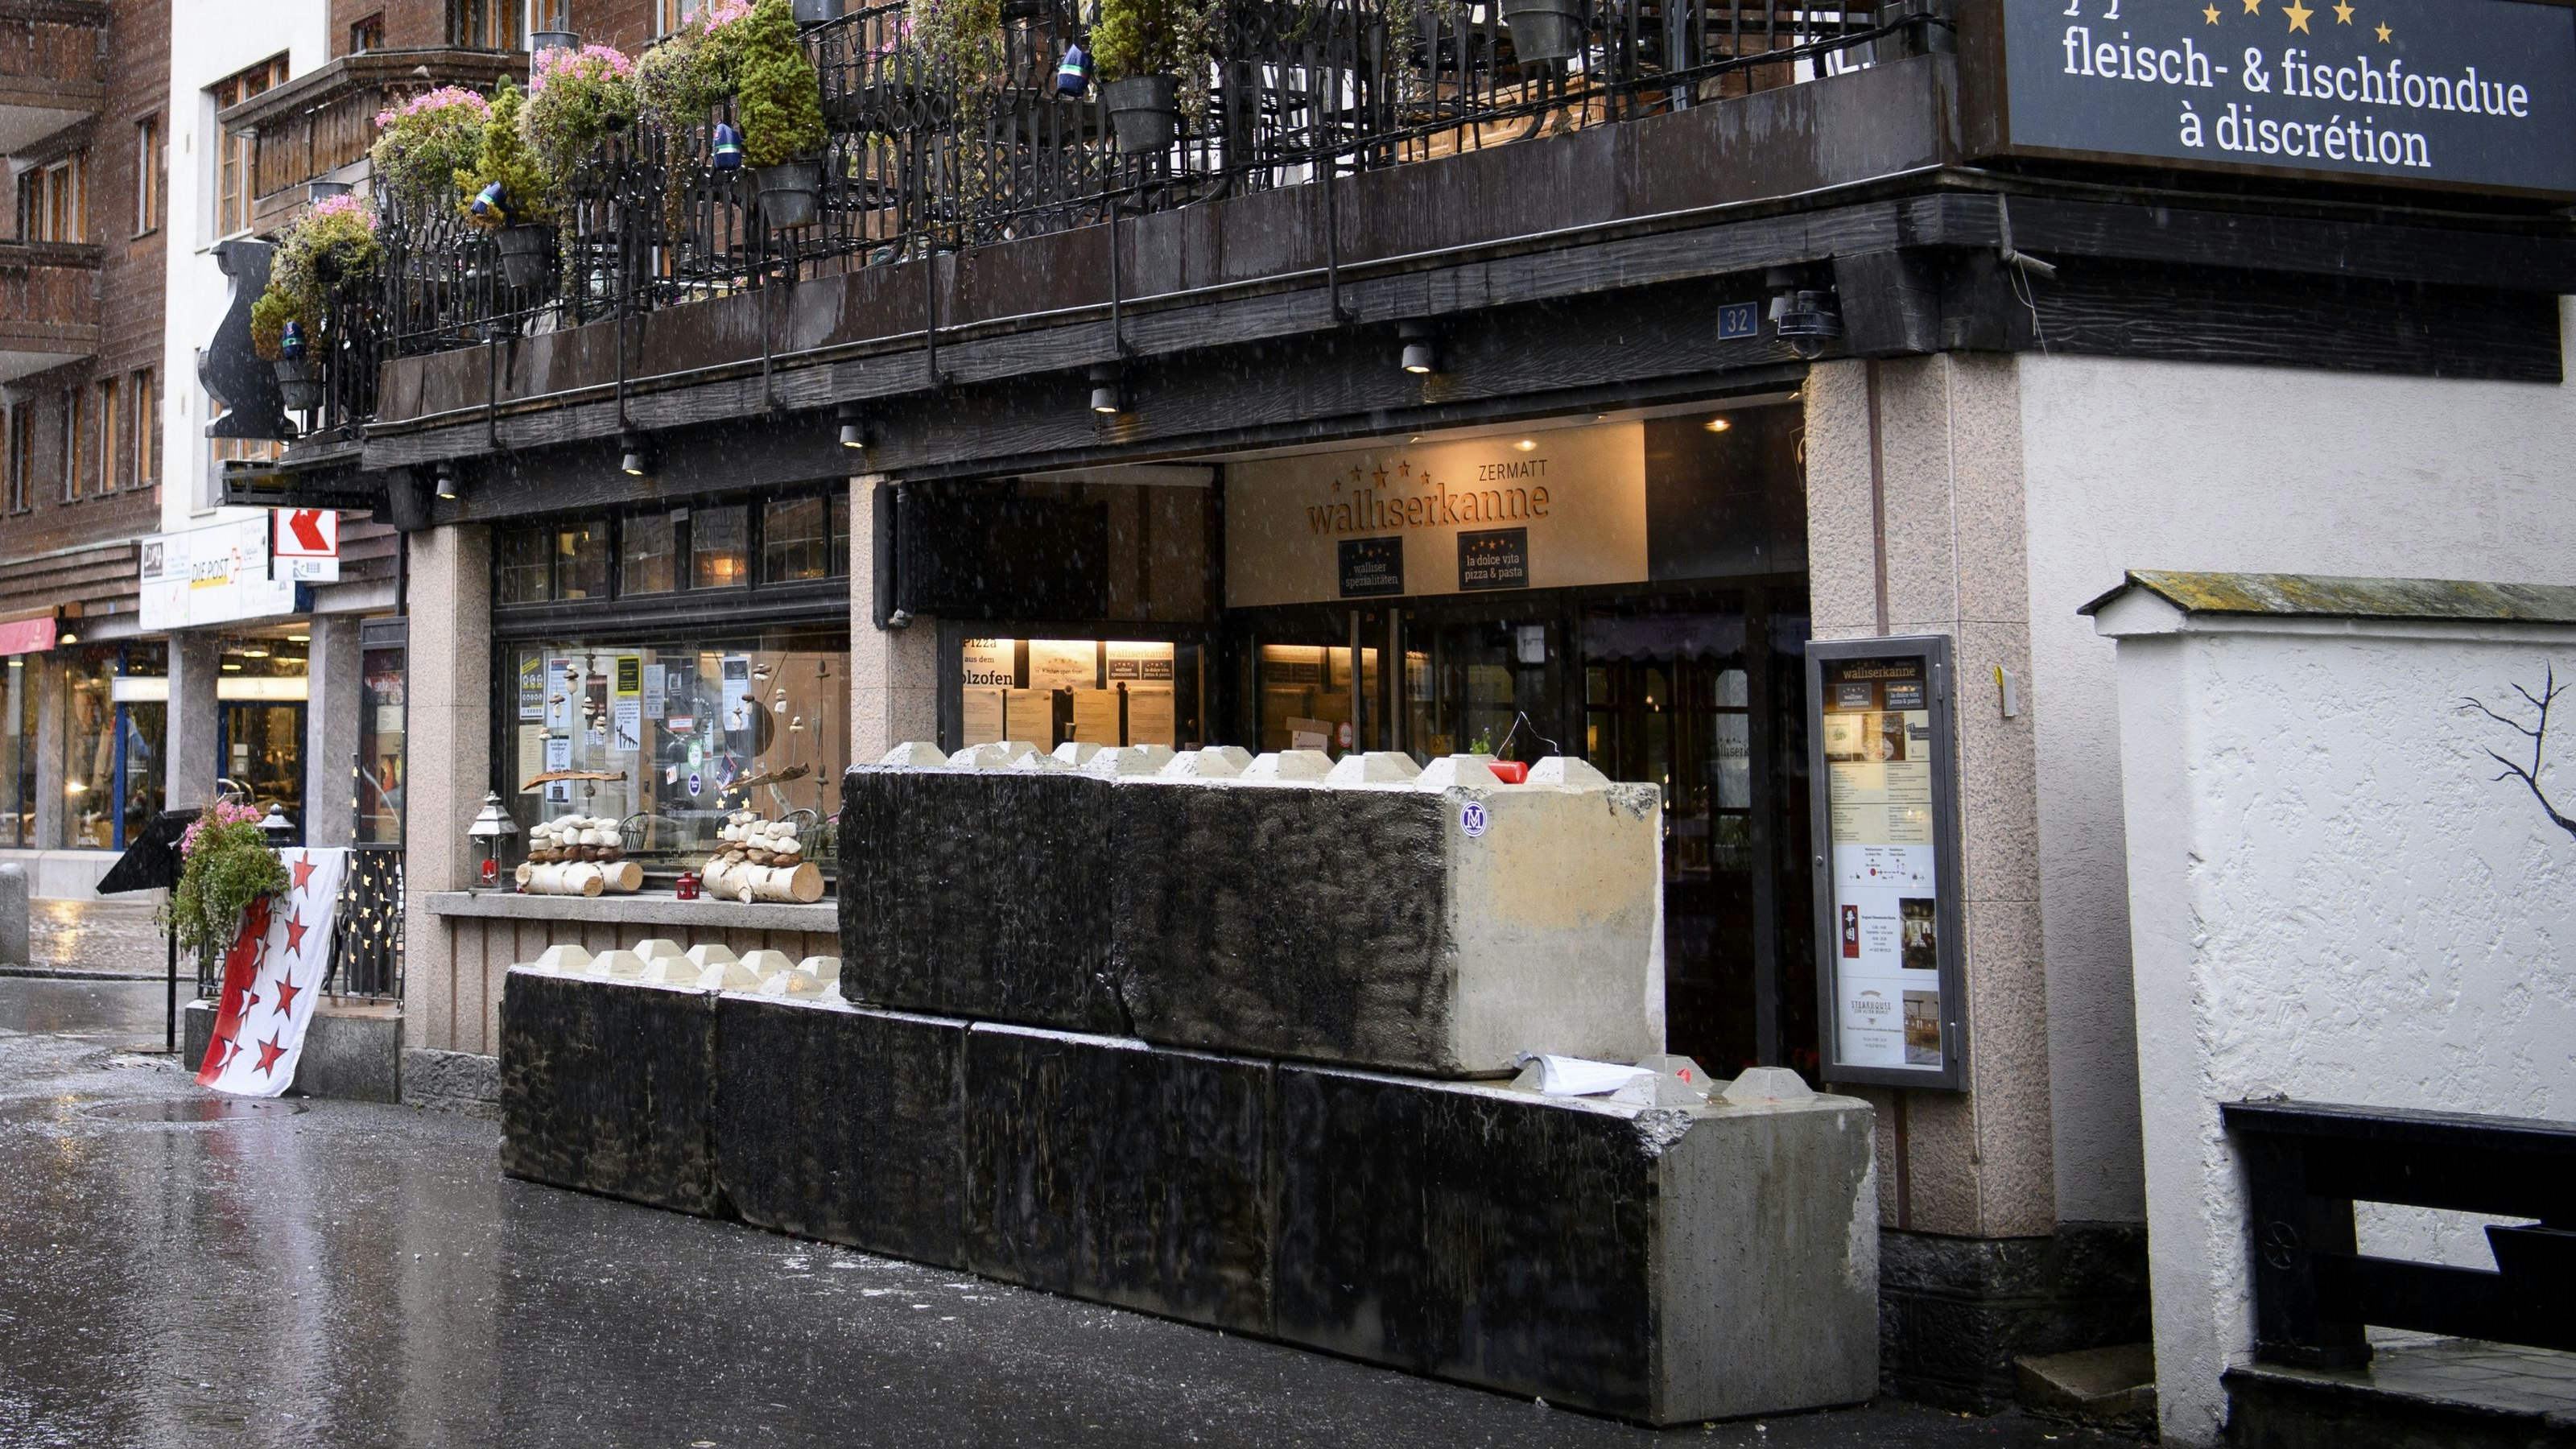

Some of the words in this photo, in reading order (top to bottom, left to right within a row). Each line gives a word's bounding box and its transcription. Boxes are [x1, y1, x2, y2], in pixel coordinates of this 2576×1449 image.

[2062, 26, 2229, 88] fleisch-
[2243, 47, 2271, 93] &
[2282, 48, 2529, 118] fischfondue
[2180, 100, 2204, 148] à
[2216, 103, 2432, 167] discrétion
[1728, 309, 1748, 332] 32
[1479, 460, 1548, 482] ZERMATT
[1307, 483, 1550, 535] walliserkanne
[1353, 562, 1387, 574] walliser
[1466, 555, 1476, 568] la
[1476, 554, 1501, 567] dolce
[1502, 553, 1520, 564] vita
[192, 562, 206, 584] DIE
[207, 558, 229, 580] POST
[1464, 568, 1488, 583] pizza
[1490, 567, 1497, 579] &
[1498, 566, 1523, 580] pasta
[1345, 574, 1399, 589] spezialitäten
[978, 655, 995, 663] dem
[1843, 667, 1915, 679] walliserkanne
